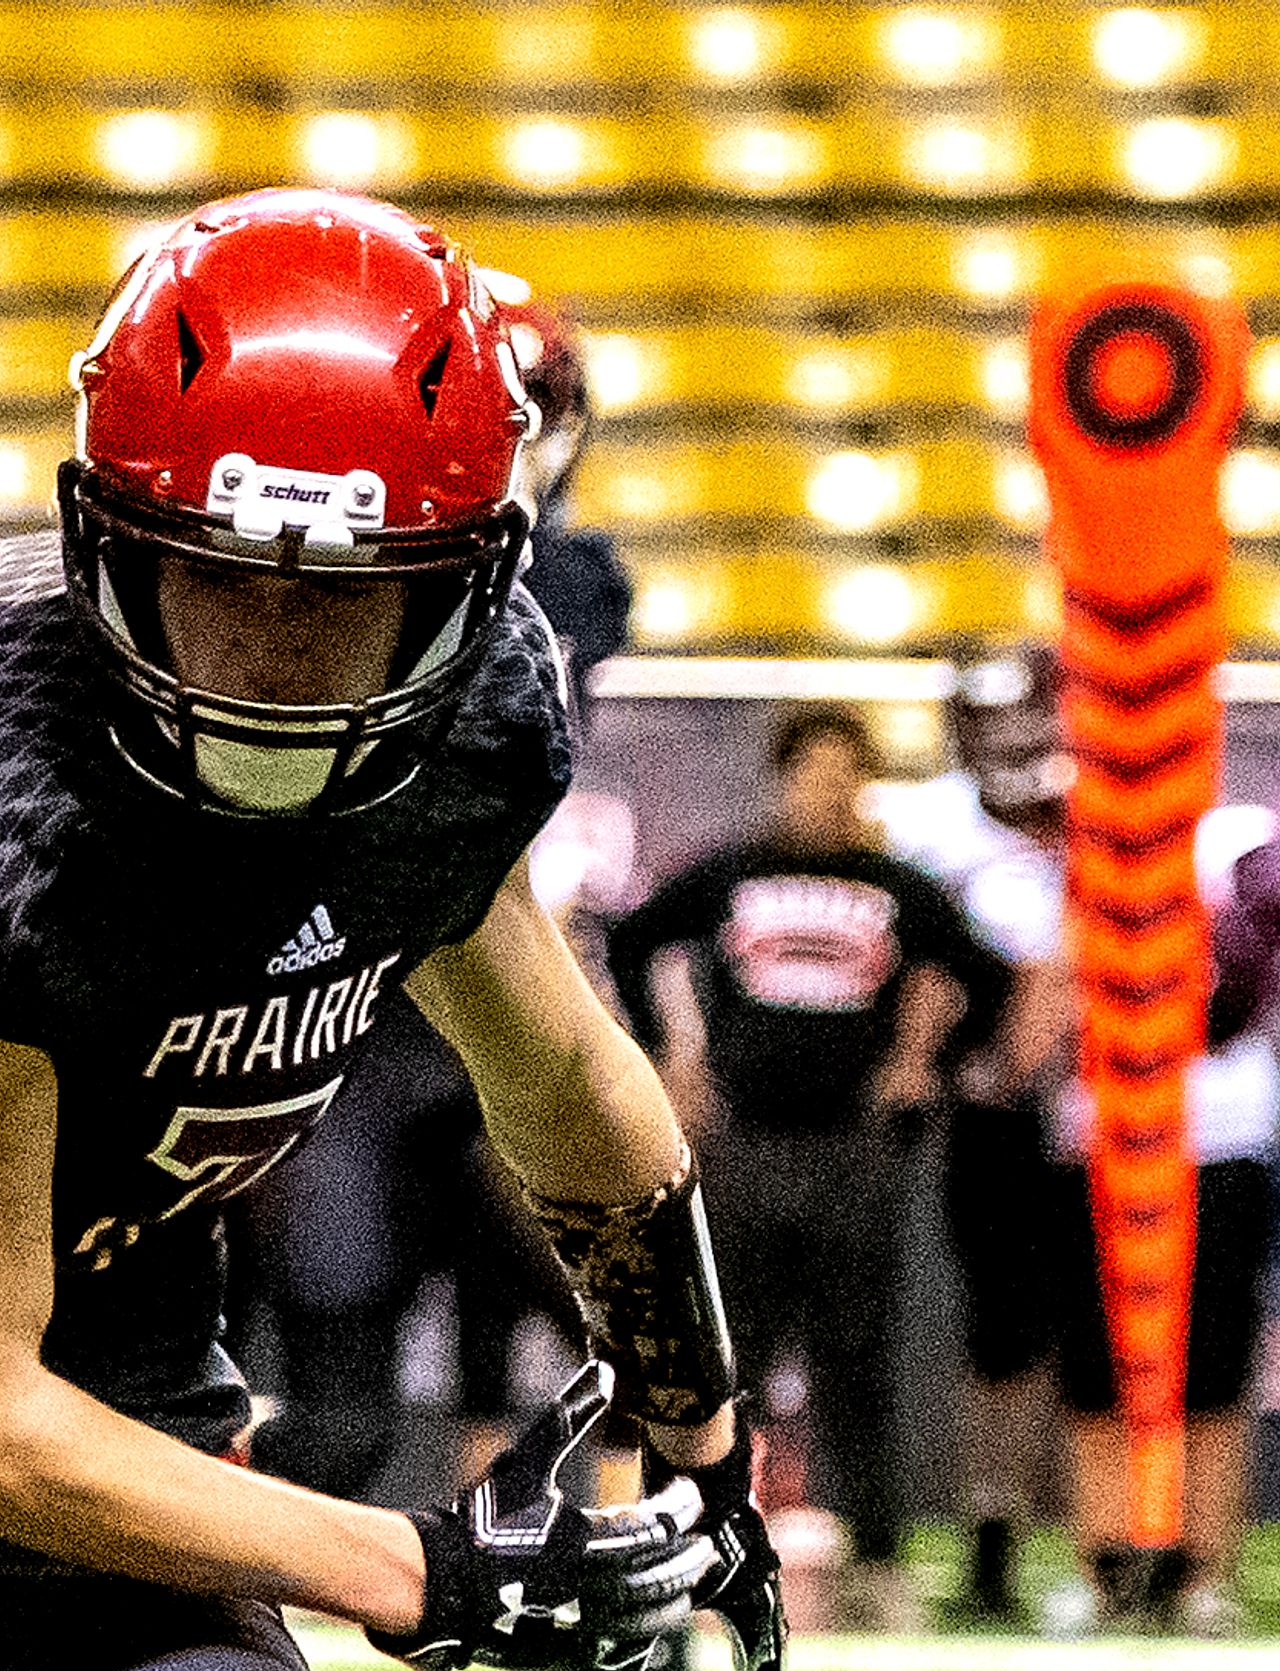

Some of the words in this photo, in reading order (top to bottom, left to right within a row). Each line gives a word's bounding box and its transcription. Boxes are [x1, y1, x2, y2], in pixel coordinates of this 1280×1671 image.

[259, 482, 331, 505] schutt
[265, 936, 347, 977] adidas
[143, 952, 401, 1078] PRAIRIE
